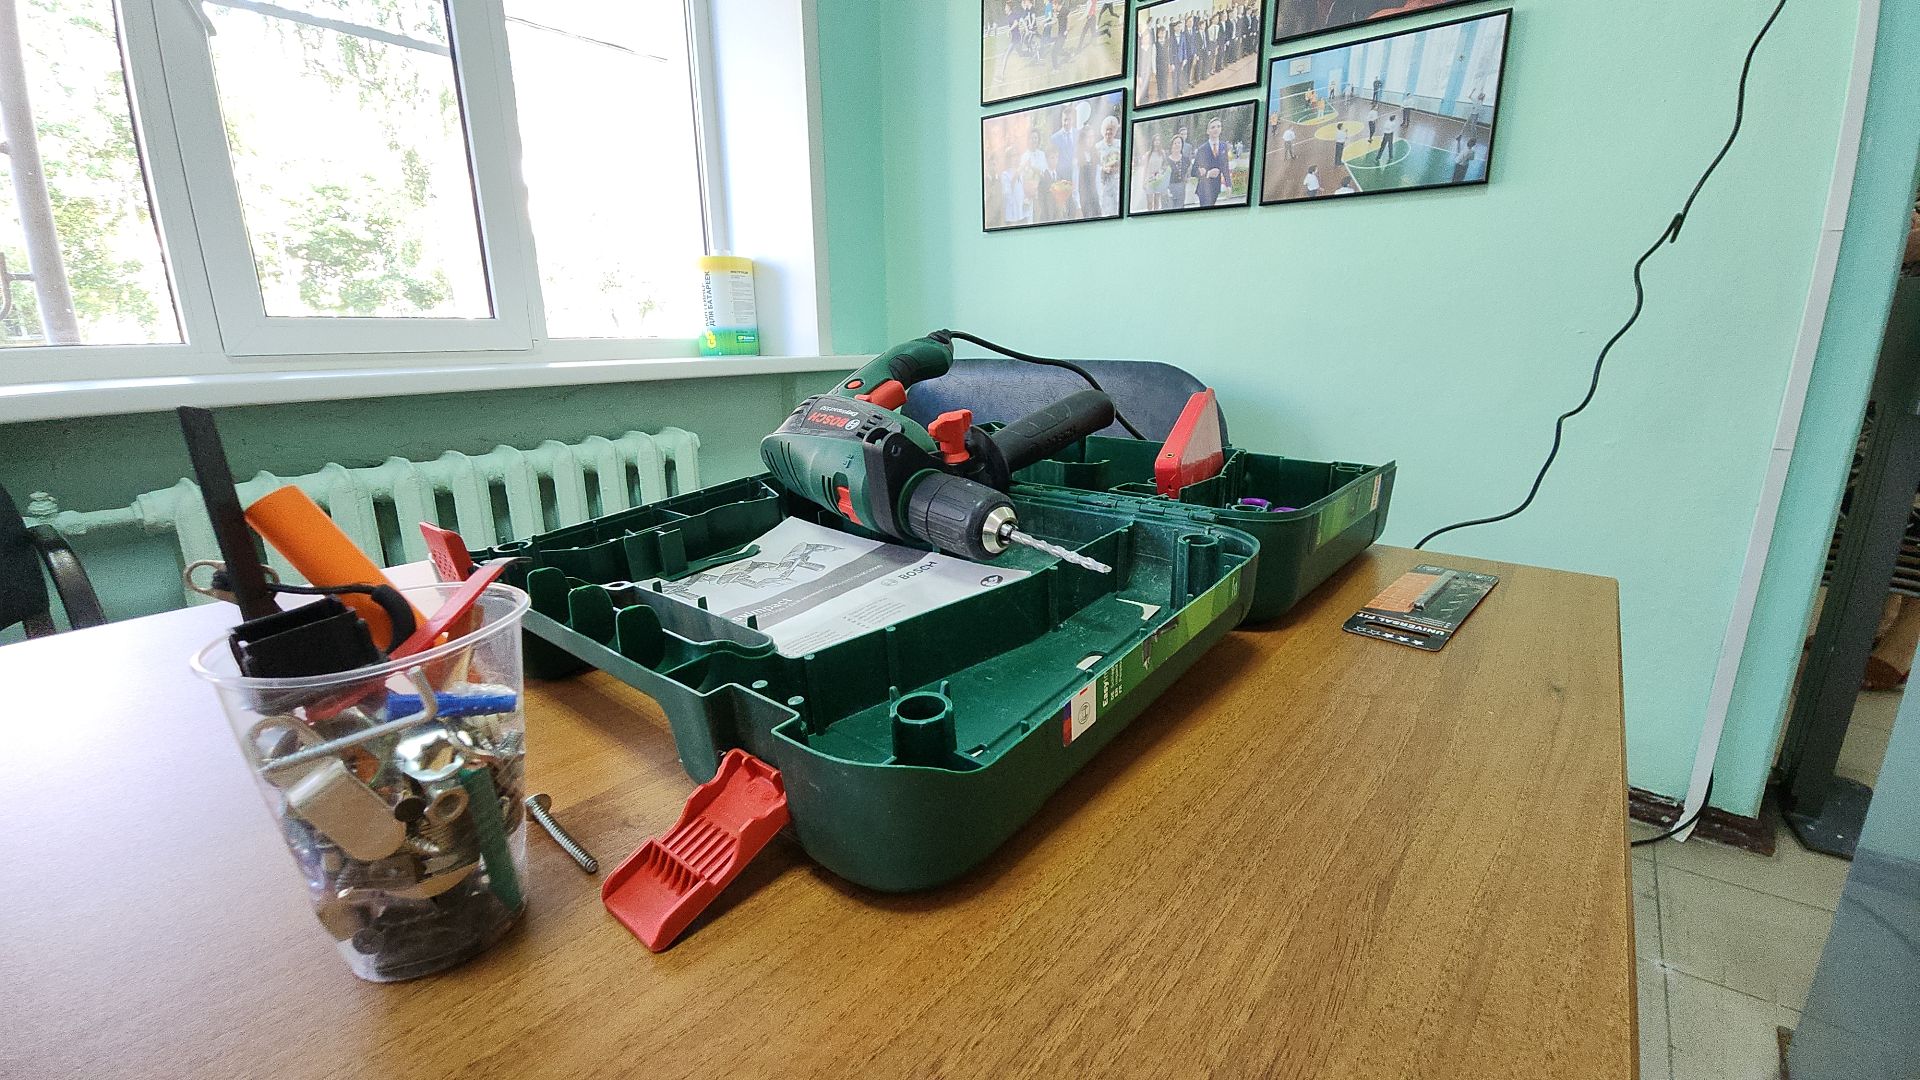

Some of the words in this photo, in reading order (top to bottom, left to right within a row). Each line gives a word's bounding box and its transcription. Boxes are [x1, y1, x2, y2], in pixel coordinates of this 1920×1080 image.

[704, 271, 713, 310] БАТАРЕЕК
[708, 311, 716, 327] ДЛЯ
[807, 411, 849, 428] BOSCH
[898, 560, 937, 580] BOSCH
[1377, 616, 1445, 636] UNIVERSAL
